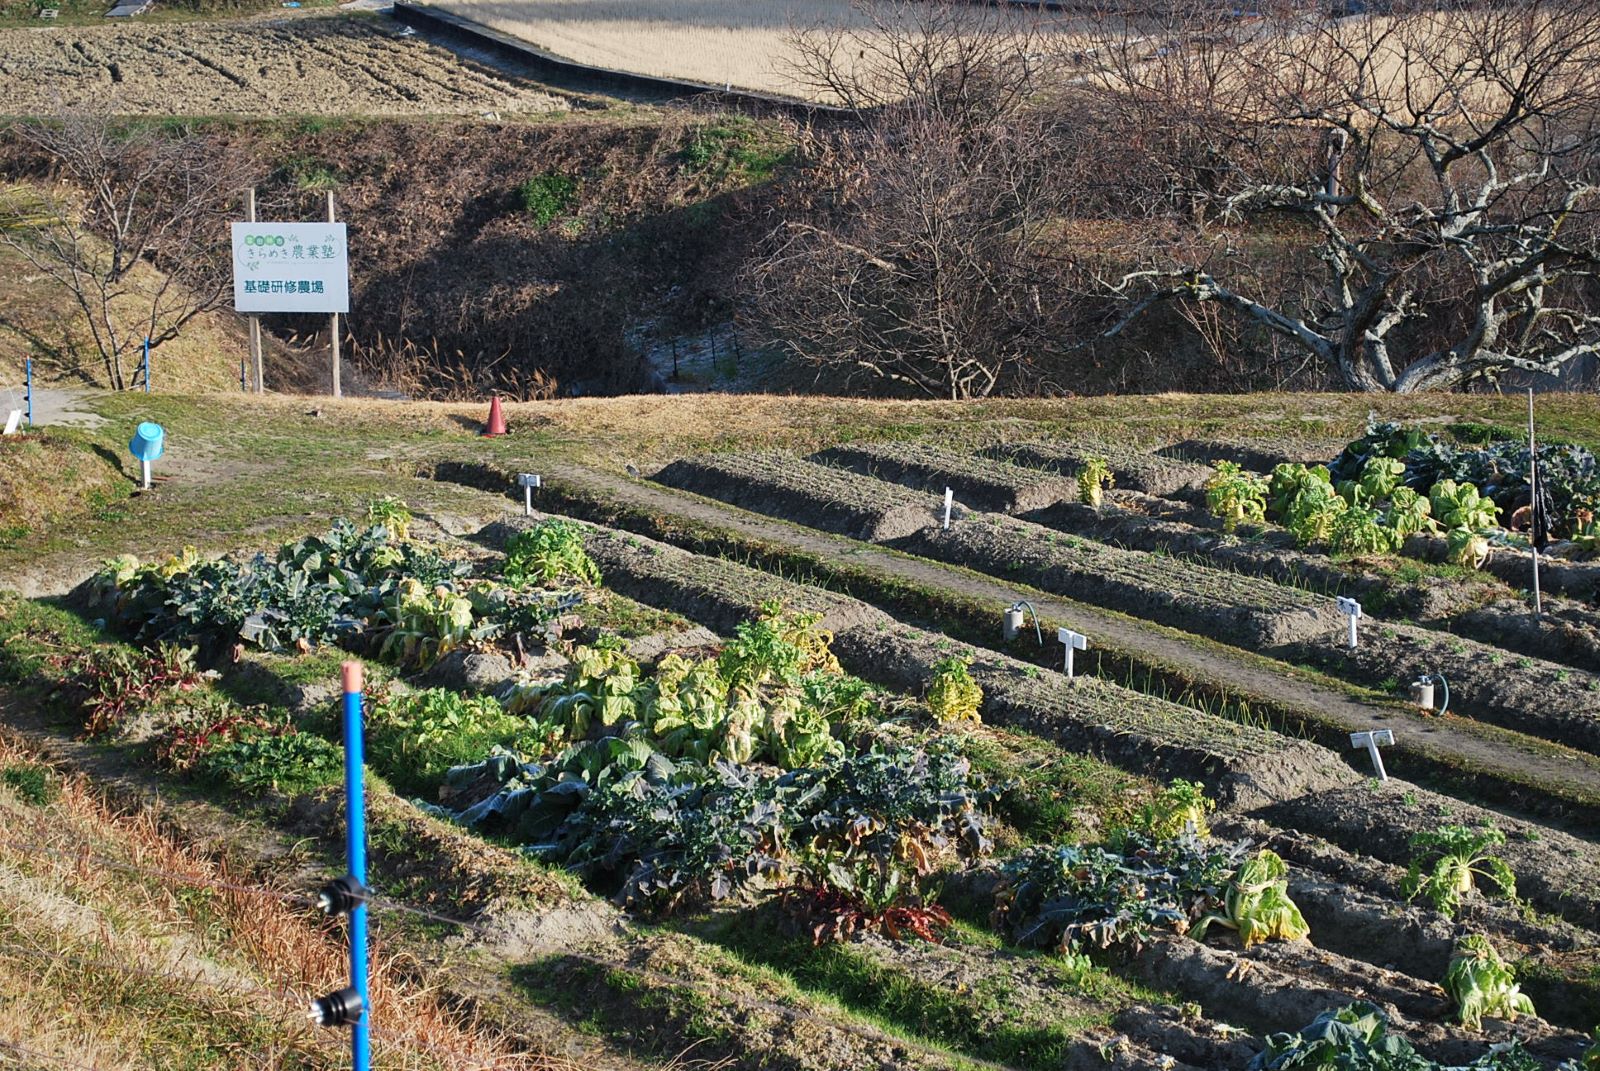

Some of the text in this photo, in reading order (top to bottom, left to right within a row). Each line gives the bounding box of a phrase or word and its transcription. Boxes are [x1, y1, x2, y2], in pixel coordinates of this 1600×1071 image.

[248, 245, 335, 259] きらめき農業塾
[245, 280, 323, 294] 基礎研修農場
